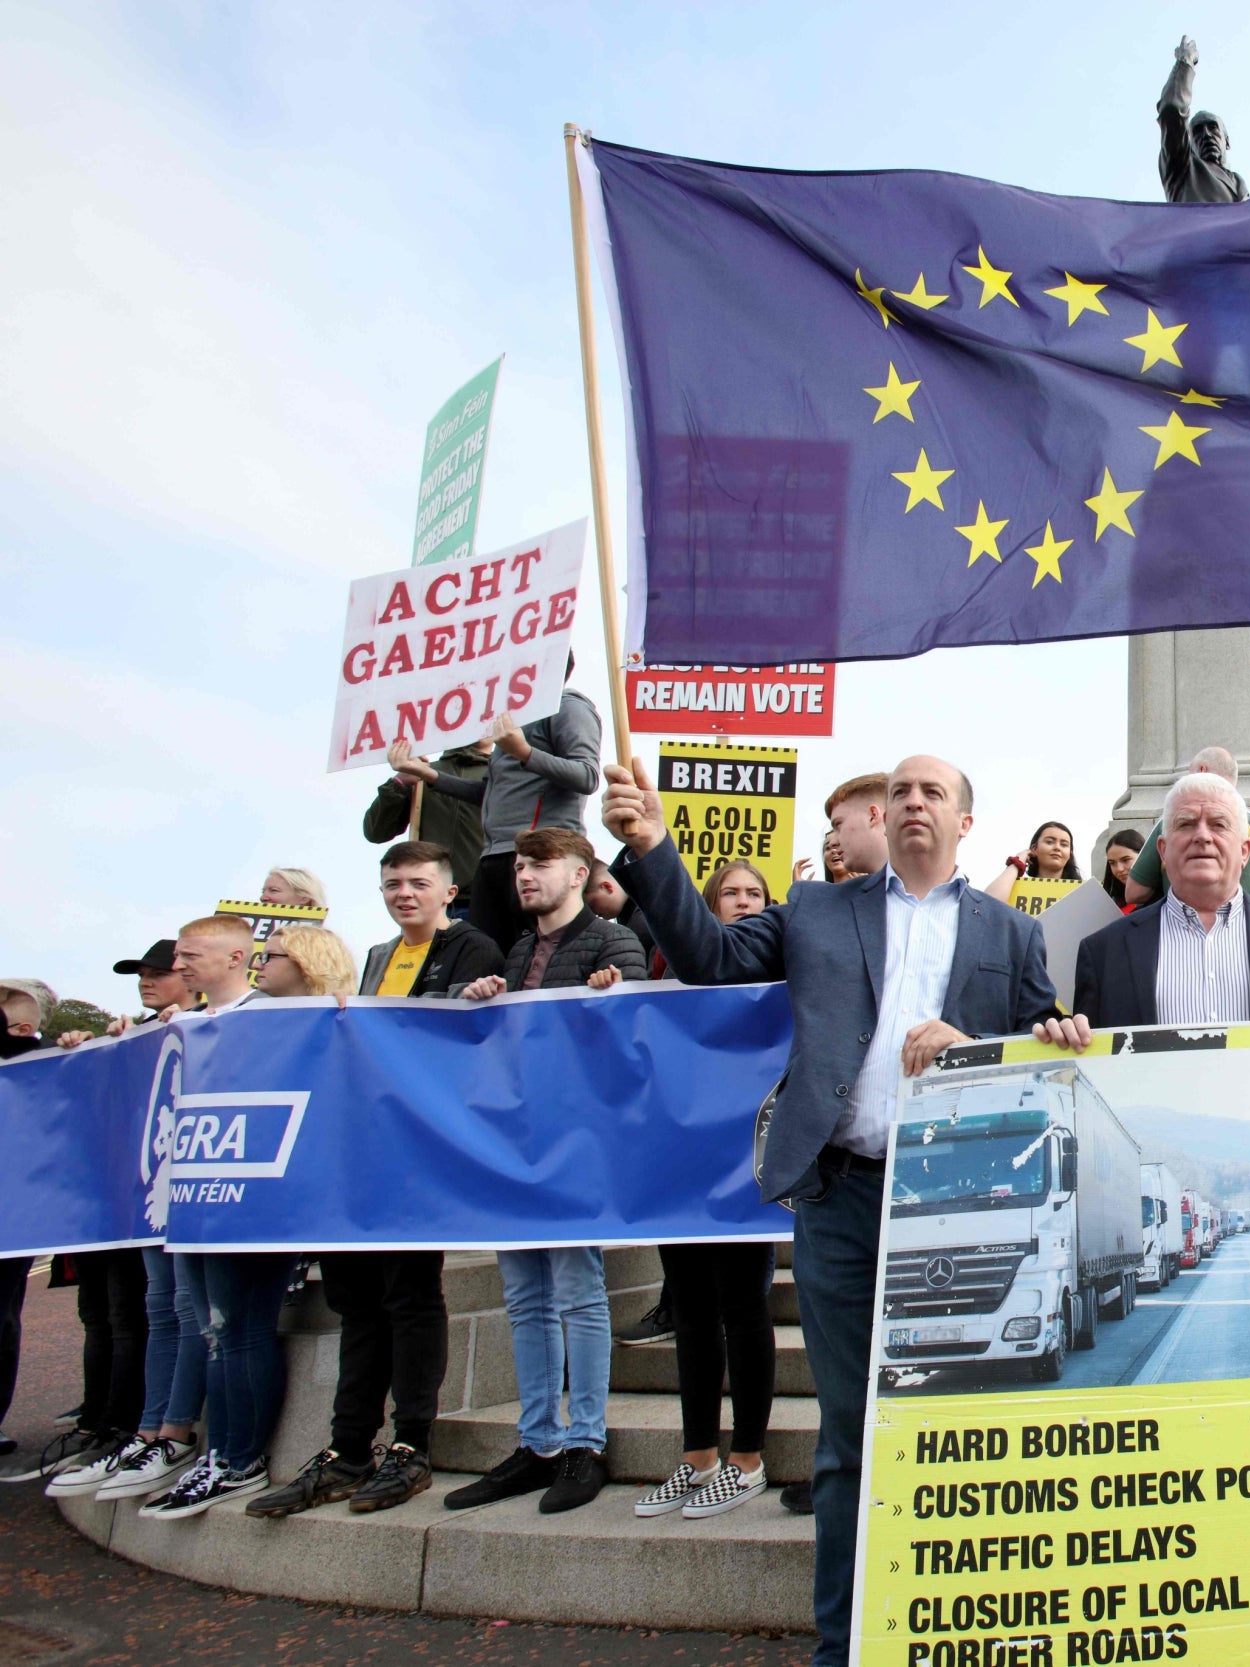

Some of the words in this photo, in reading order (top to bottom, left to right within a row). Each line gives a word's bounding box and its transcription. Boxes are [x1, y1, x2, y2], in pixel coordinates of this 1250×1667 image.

[437, 414, 460, 449] Sinn
[419, 453, 460, 506] PROTECT
[462, 425, 485, 462] THE
[417, 500, 440, 538] GOOD
[441, 457, 482, 514] FRIDAY
[416, 496, 473, 564] AGREEMENT
[378, 548, 541, 624] ACHT
[343, 586, 577, 684] GAEILGE
[635, 680, 746, 712] REMAIN
[751, 682, 824, 714] VOTE
[671, 761, 785, 793] BREXIT
[673, 805, 691, 828] A
[705, 806, 777, 832] COLD
[678, 831, 771, 857] HOUSE
[173, 1114, 247, 1161] GRA
[196, 1178, 246, 1203] FÉIN
[916, 1427, 1009, 1464] HARD
[1021, 1419, 1160, 1459] BORDER
[913, 1477, 1079, 1520] CUSTOMS
[1090, 1469, 1206, 1510] CHECK
[910, 1533, 1054, 1576] TRAFFIC
[1066, 1524, 1197, 1567] DELAYS
[908, 1589, 1070, 1634] CLOSURE
[1082, 1585, 1126, 1622] OF
[1139, 1575, 1250, 1618] LOCAL
[1067, 1623, 1188, 1666] ROADS
